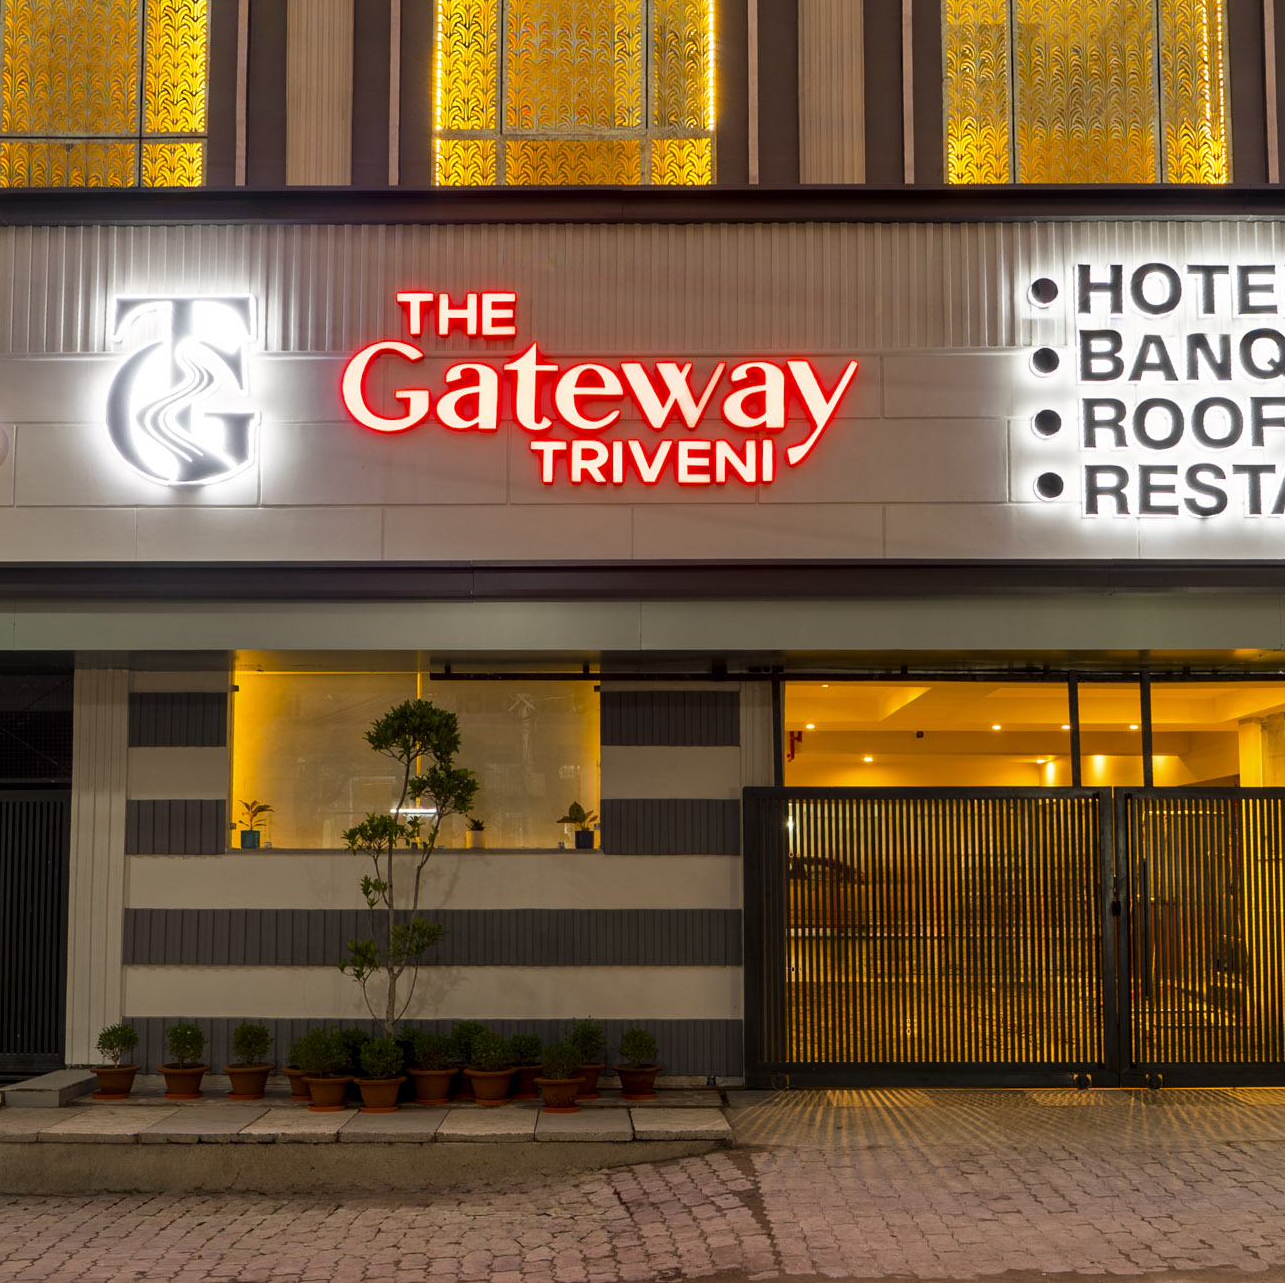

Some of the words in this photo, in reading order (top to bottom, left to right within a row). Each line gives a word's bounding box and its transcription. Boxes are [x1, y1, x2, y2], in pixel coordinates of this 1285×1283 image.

[396, 291, 517, 338] THE
[340, 339, 859, 467] Gateway
[529, 437, 776, 486] TRIVENI
